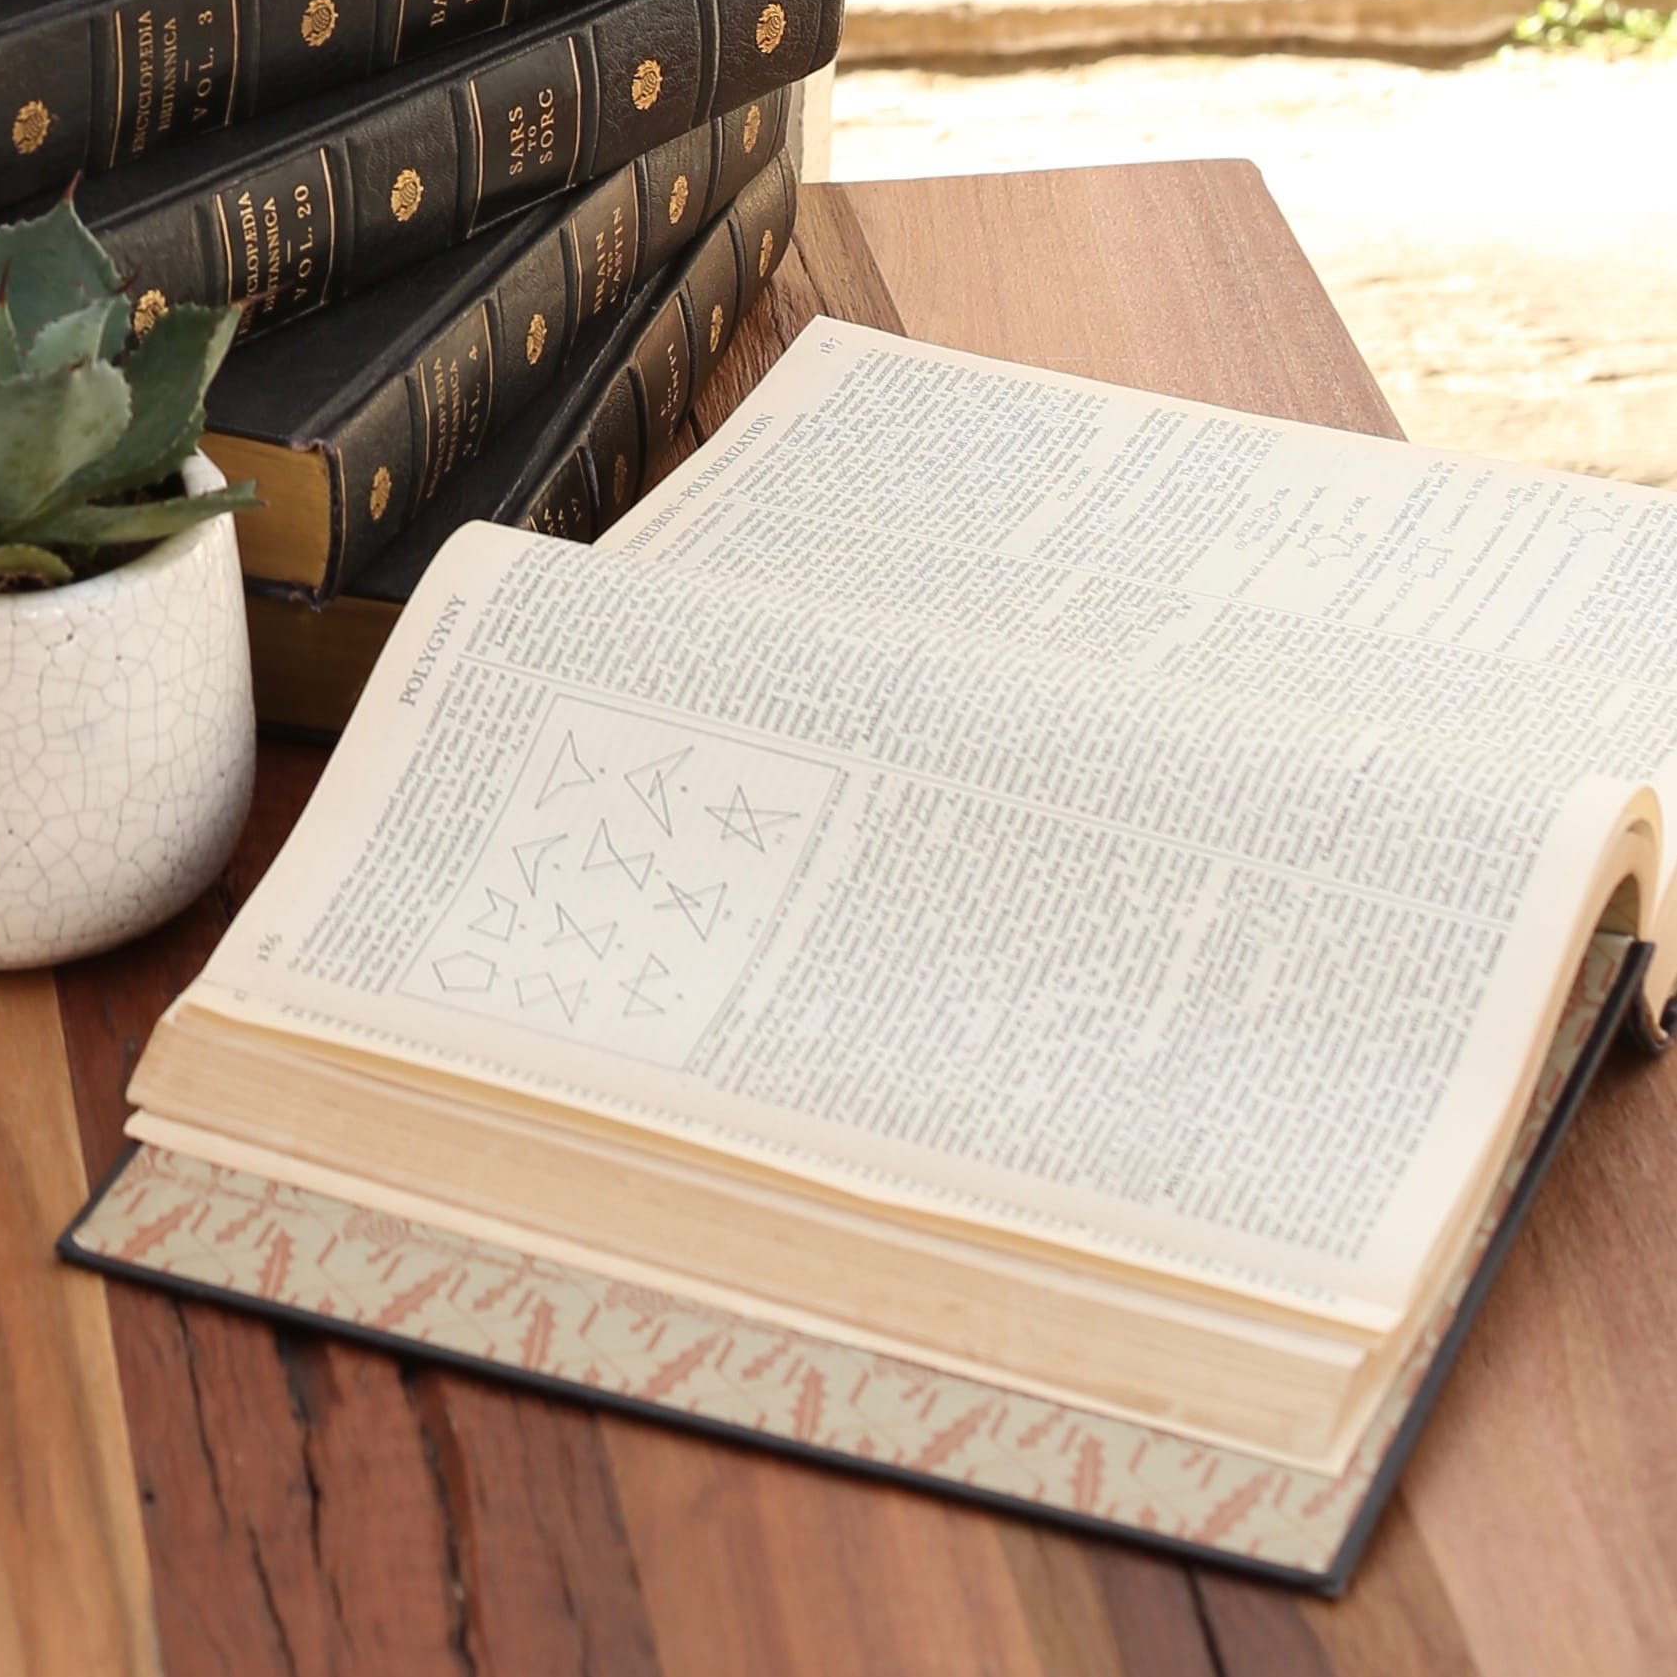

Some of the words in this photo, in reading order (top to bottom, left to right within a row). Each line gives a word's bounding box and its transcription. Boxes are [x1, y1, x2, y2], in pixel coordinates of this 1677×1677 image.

[198, 10, 213, 25] 3
[157, 17, 177, 131] BRITANNICA
[192, 46, 214, 121] VOL.
[508, 106, 524, 175] SARS
[528, 125, 537, 151] TO
[539, 88, 554, 164] SORC
[294, 185, 311, 218] 20
[294, 226, 313, 301] VOL.
[593, 231, 605, 314] BRAIN
[468, 344, 479, 361] 4
[819, 336, 843, 356] 187
[399, 594, 466, 707] POLYGYNY
